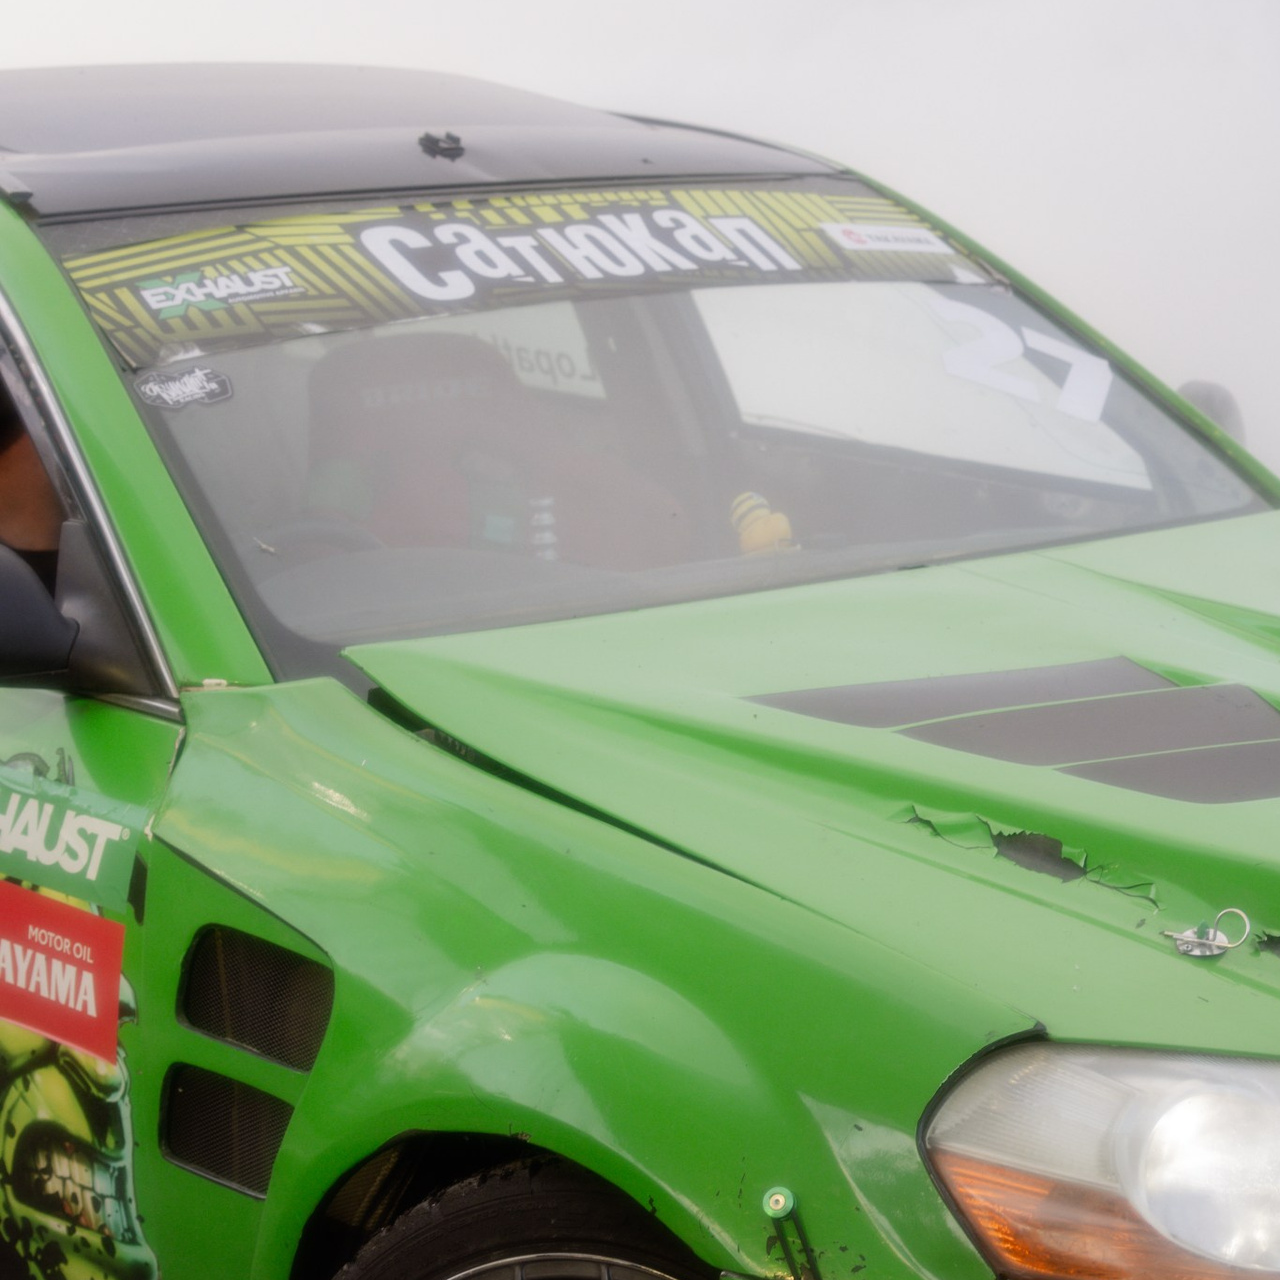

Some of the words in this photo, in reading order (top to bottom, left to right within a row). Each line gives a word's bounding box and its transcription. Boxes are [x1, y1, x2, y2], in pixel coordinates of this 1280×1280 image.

[140, 266, 294, 311] EXHAUST
[28, 924, 71, 955] MOTOR
[72, 942, 94, 964] OIL
[0, 938, 97, 1018] AYAMA
